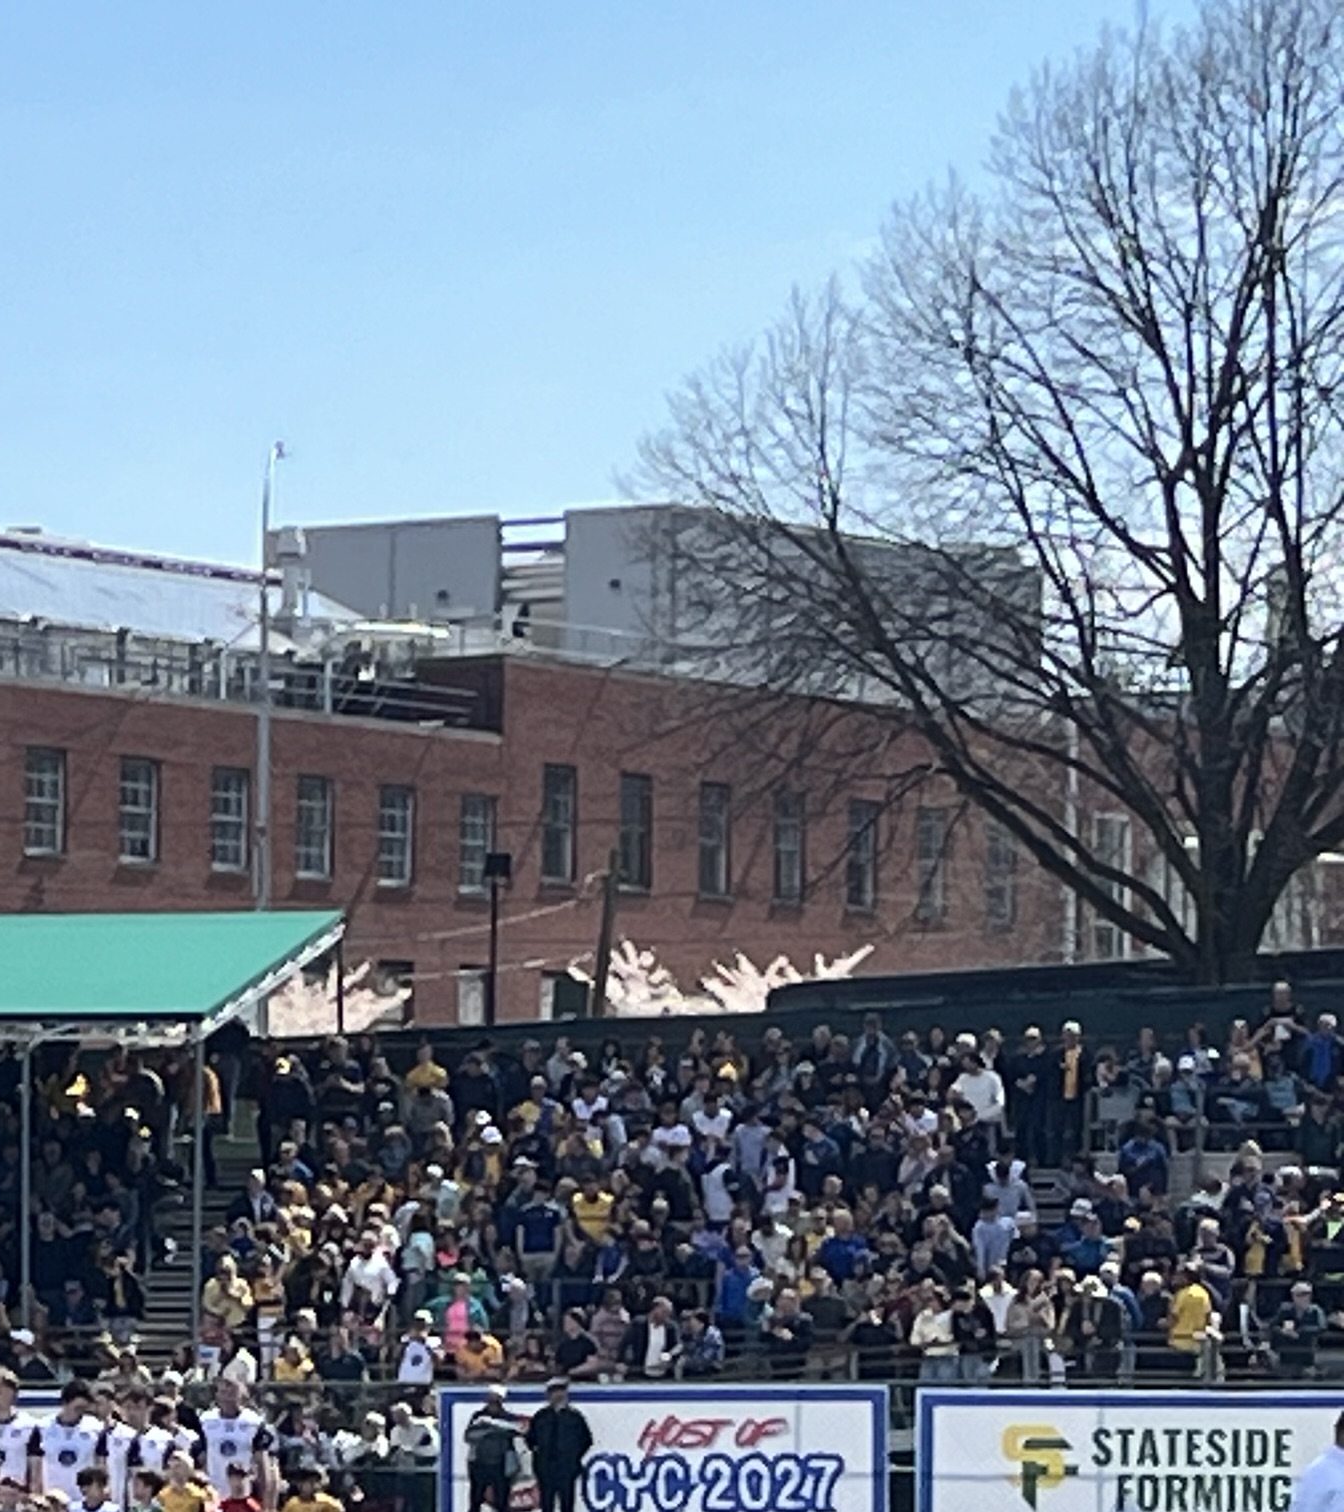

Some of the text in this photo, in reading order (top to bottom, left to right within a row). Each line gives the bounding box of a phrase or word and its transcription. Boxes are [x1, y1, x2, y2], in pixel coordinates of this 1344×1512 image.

[638, 1414, 789, 1456] HOST OF
[1091, 1427, 1293, 1467] STATESIDE
[1115, 1474, 1292, 1512] FORMING
